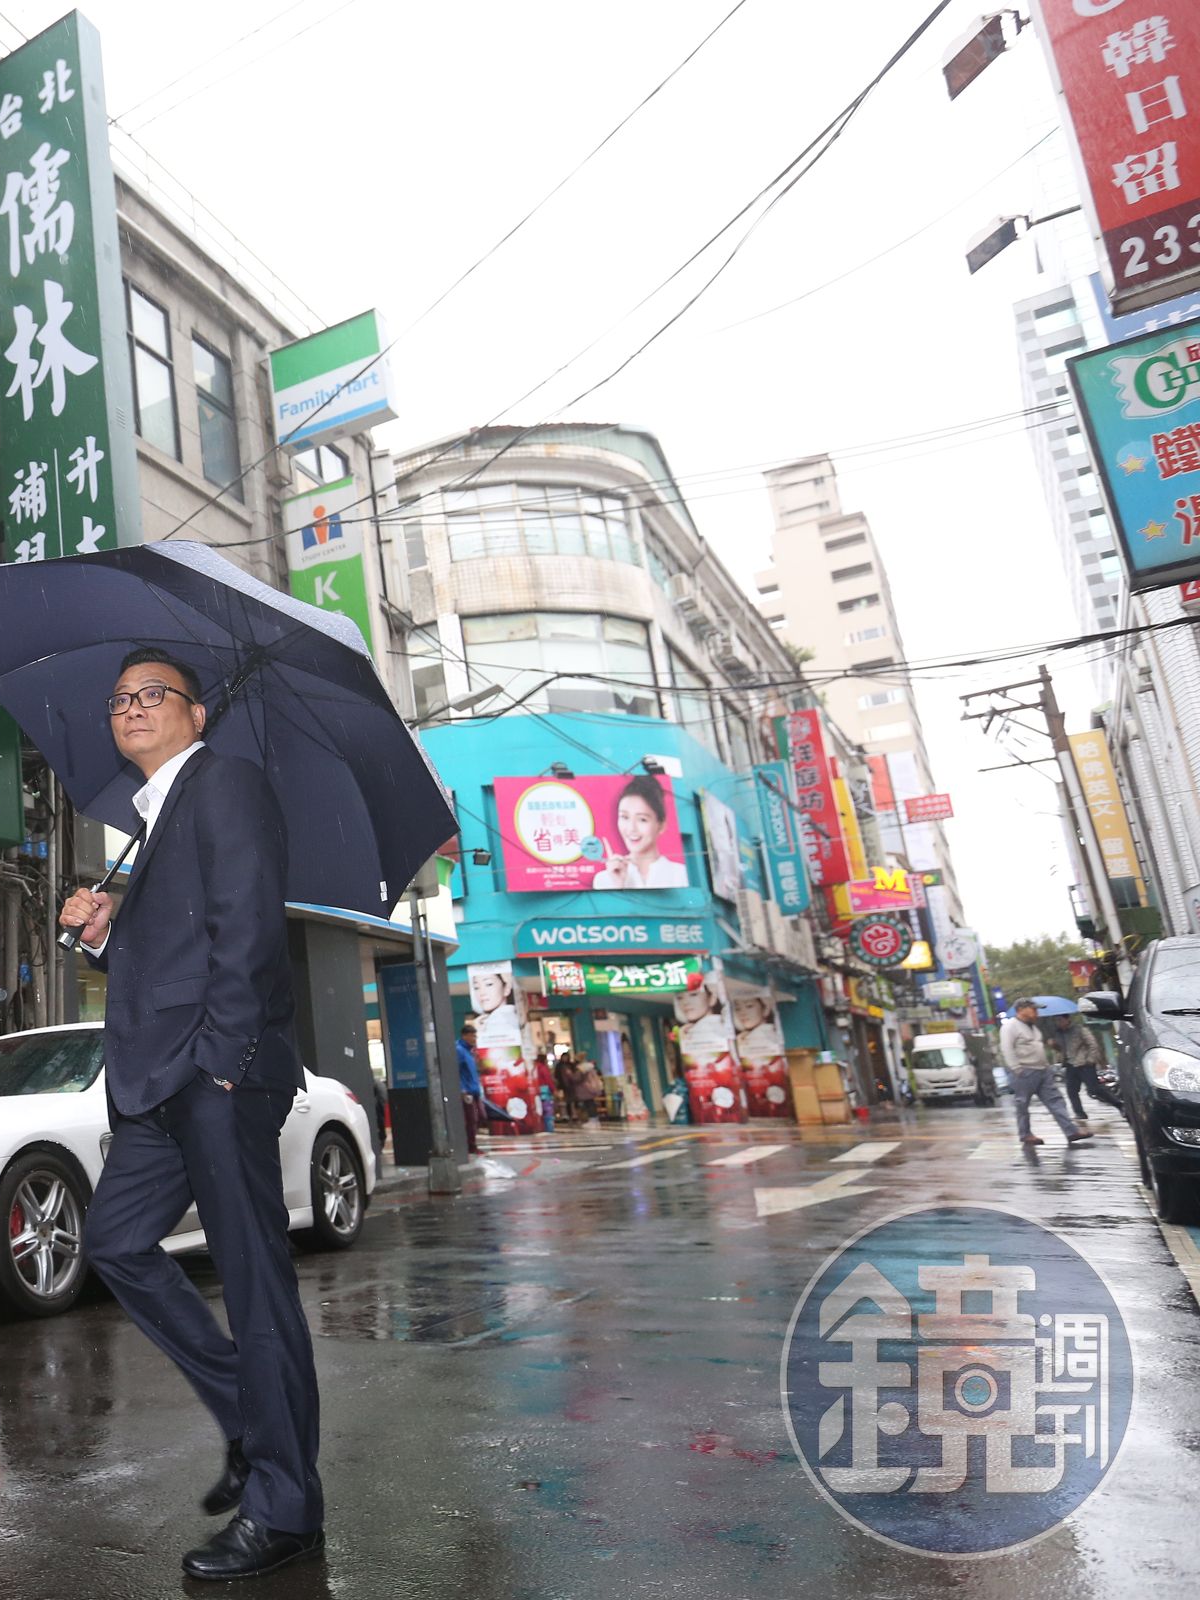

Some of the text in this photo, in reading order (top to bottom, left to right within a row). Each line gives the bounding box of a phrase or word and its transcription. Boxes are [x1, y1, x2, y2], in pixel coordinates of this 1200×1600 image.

[279, 370, 379, 419] FamilyMart
[531, 924, 648, 945] watsons
[605, 961, 688, 988] 2件5折
